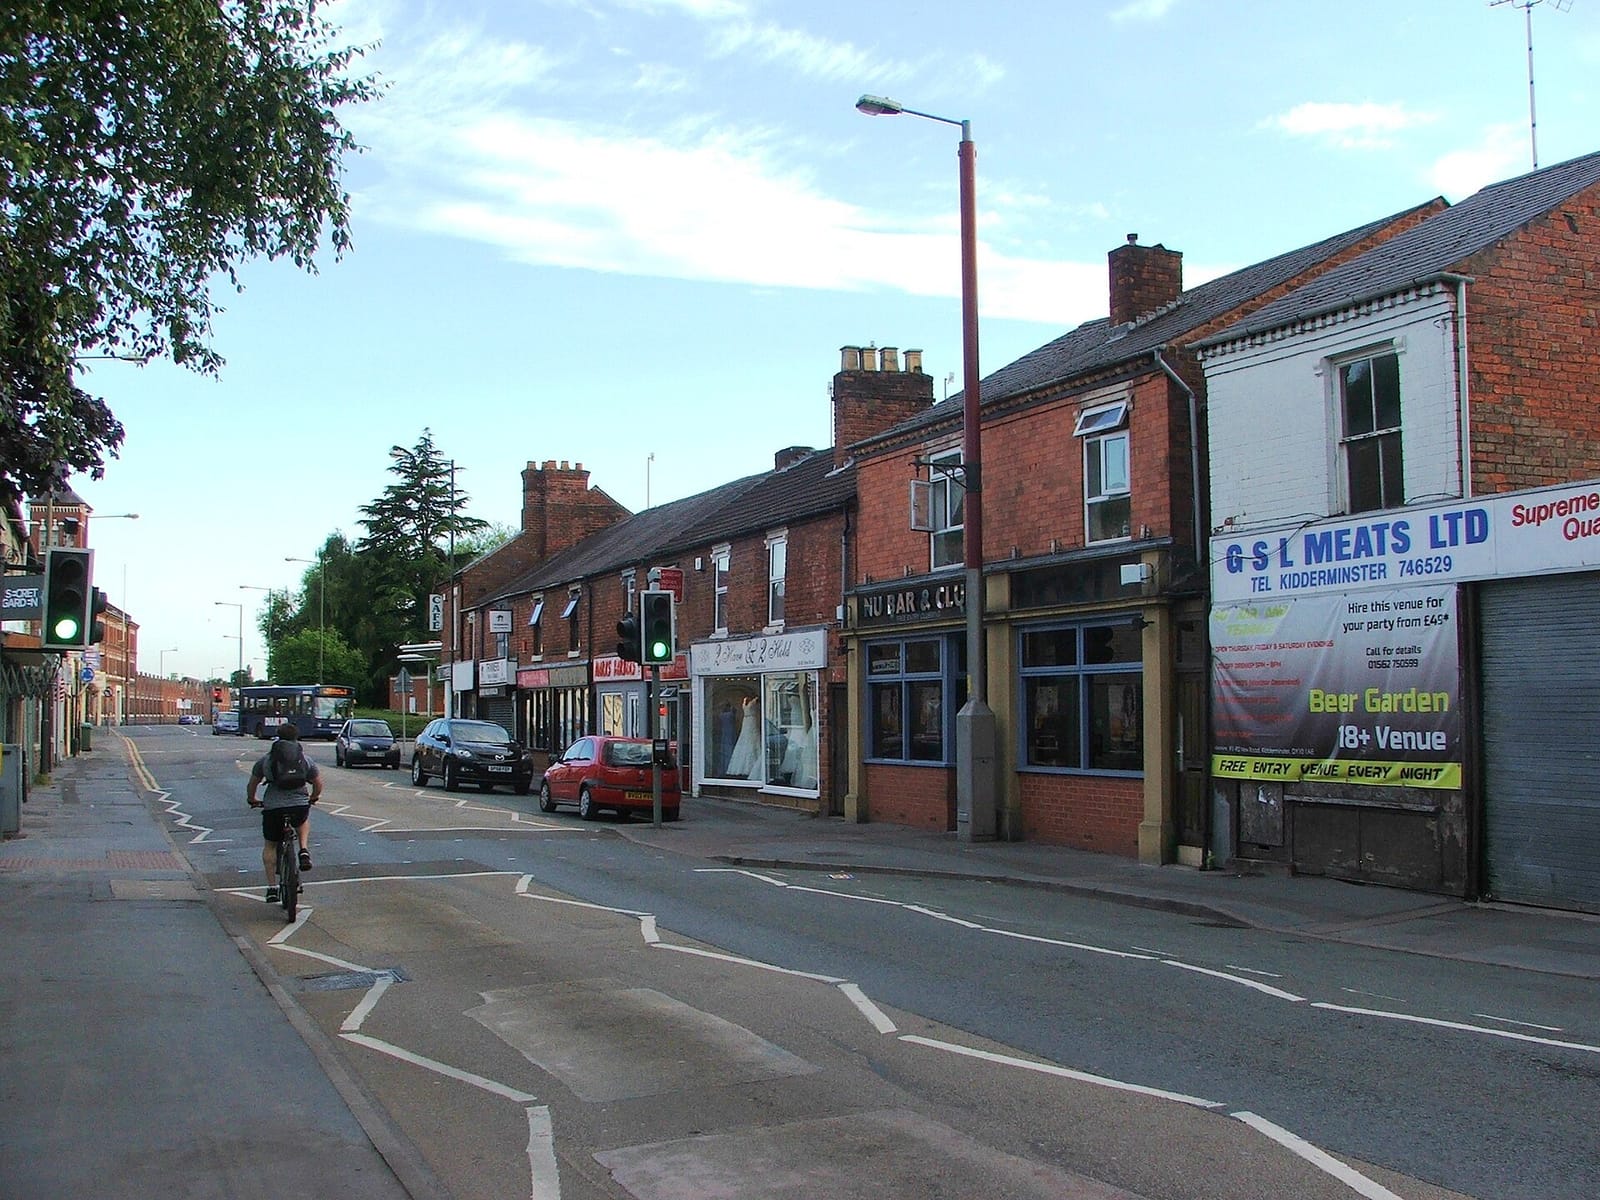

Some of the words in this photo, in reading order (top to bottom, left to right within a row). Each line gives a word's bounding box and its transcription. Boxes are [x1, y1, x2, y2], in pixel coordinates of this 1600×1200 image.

[1511, 493, 1600, 527] Supreme
[1226, 544, 1242, 574] G
[1252, 541, 1269, 571] S
[1279, 538, 1294, 568] L
[1304, 521, 1411, 566] MEATS
[1429, 508, 1489, 549] LTD
[1251, 576, 1272, 593] TEL
[1279, 563, 1387, 590] KIDDERMINSTER
[1398, 556, 1452, 578] 746529
[2, 598, 39, 608] GARDEN
[887, 591, 916, 615] BAR
[920, 588, 931, 611] &
[935, 584, 965, 609] CLU
[1348, 602, 1368, 614] Hire
[1371, 600, 1390, 612] this
[1393, 599, 1423, 611] venue
[1426, 596, 1444, 609] for
[431, 596, 442, 630] CAFE
[1343, 621, 1364, 633] your
[1367, 618, 1394, 632] party
[1396, 617, 1421, 628] from
[1366, 647, 1381, 656] Call
[1382, 646, 1394, 655] for
[1395, 645, 1421, 655] details
[1368, 660, 1391, 669] 01562
[1309, 688, 1358, 713] Beer
[1364, 687, 1449, 713] Garden
[1338, 725, 1371, 749] 18+
[1375, 725, 1447, 750] Venue
[1219, 759, 1247, 773] FREE
[1253, 761, 1291, 775] ENTRY
[1301, 763, 1339, 776] VENUE
[1347, 765, 1392, 778] EVERY
[1400, 767, 1443, 780] NIGHT
